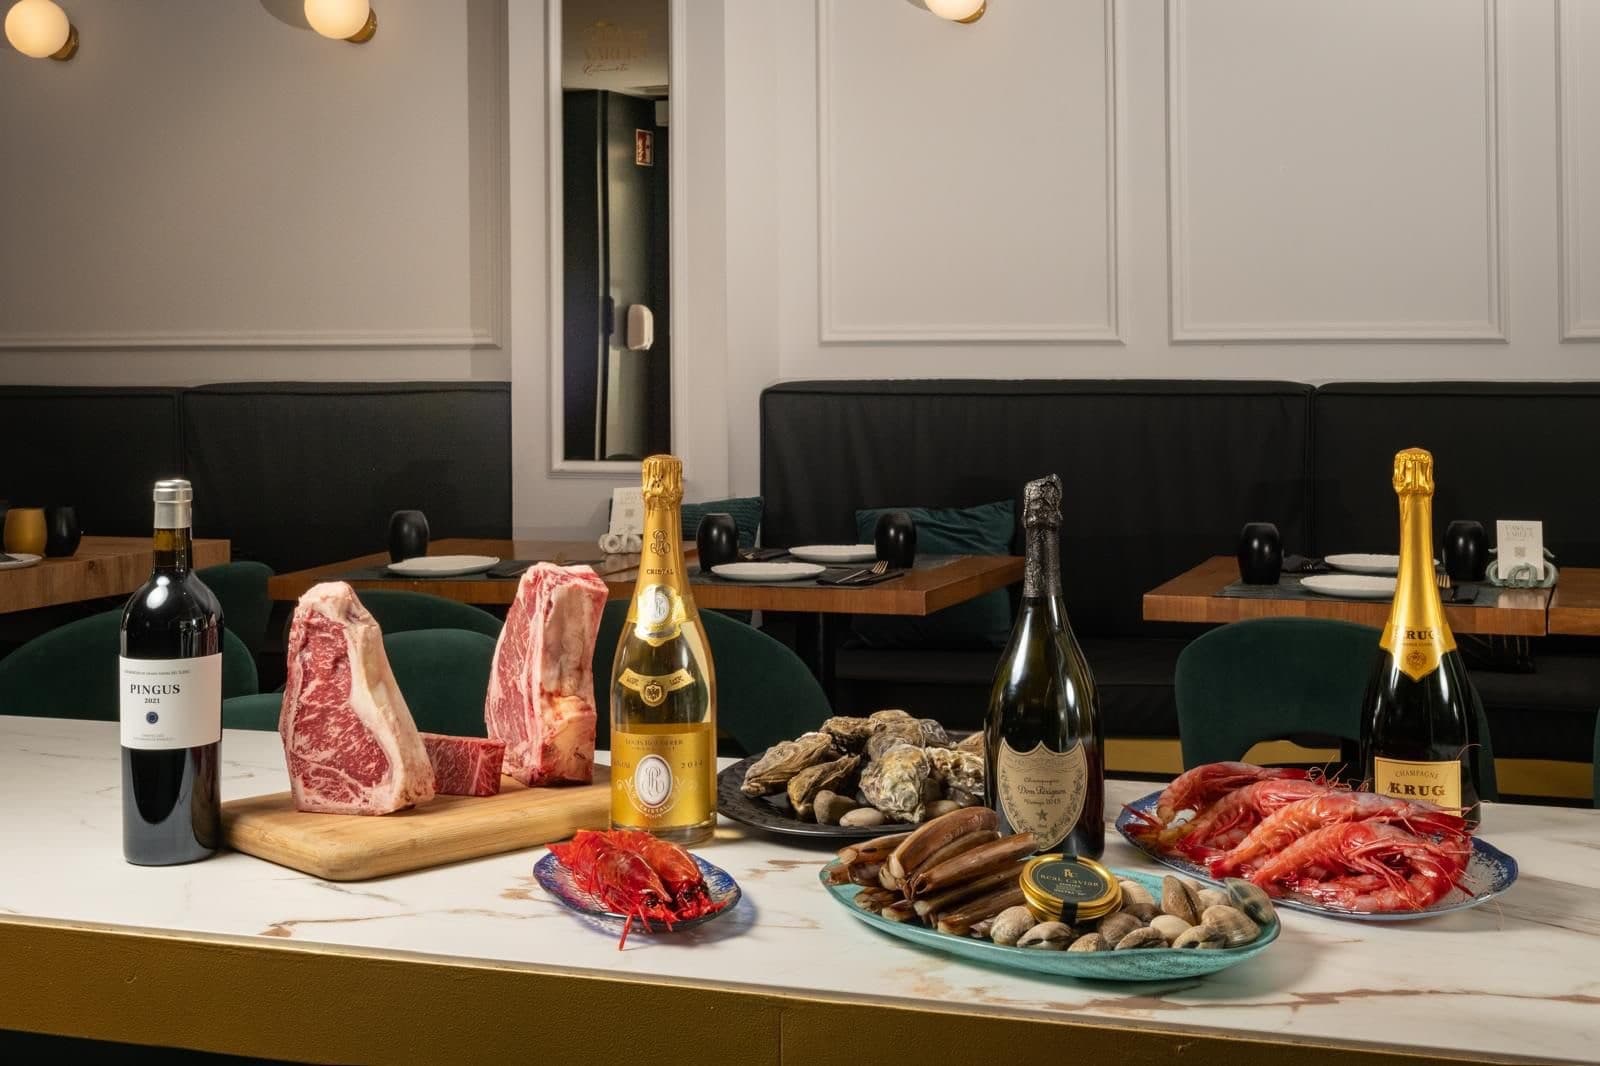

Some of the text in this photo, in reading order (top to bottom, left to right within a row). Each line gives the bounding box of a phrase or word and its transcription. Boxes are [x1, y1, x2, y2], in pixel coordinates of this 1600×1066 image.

[130, 684, 181, 695] PINGUS
[1395, 768, 1440, 780] CHAMPAGNE
[1389, 781, 1446, 797] KRUG
